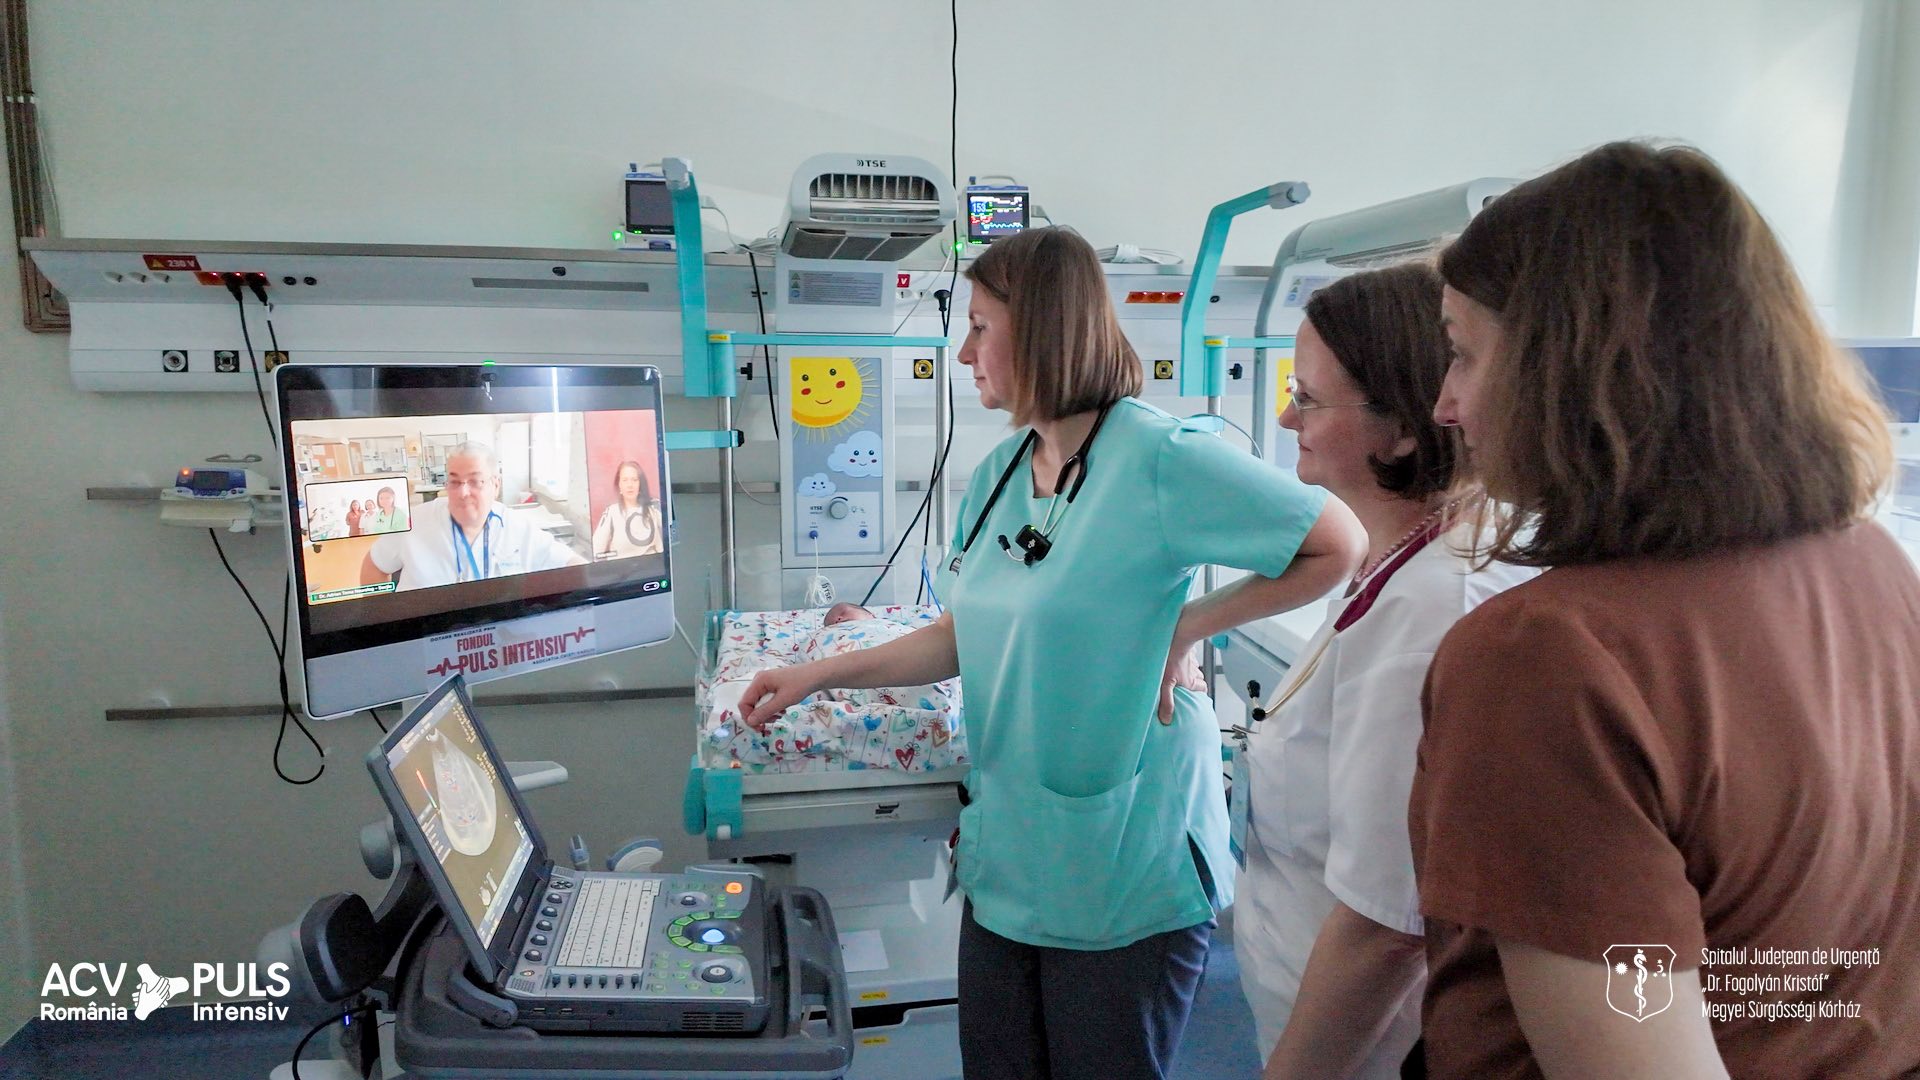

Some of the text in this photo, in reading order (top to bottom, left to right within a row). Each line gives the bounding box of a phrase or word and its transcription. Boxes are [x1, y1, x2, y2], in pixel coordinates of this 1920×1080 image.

[866, 160, 886, 168] TSE
[456, 633, 495, 652] FONDUL
[458, 634, 567, 675] PULS INTENSIV
